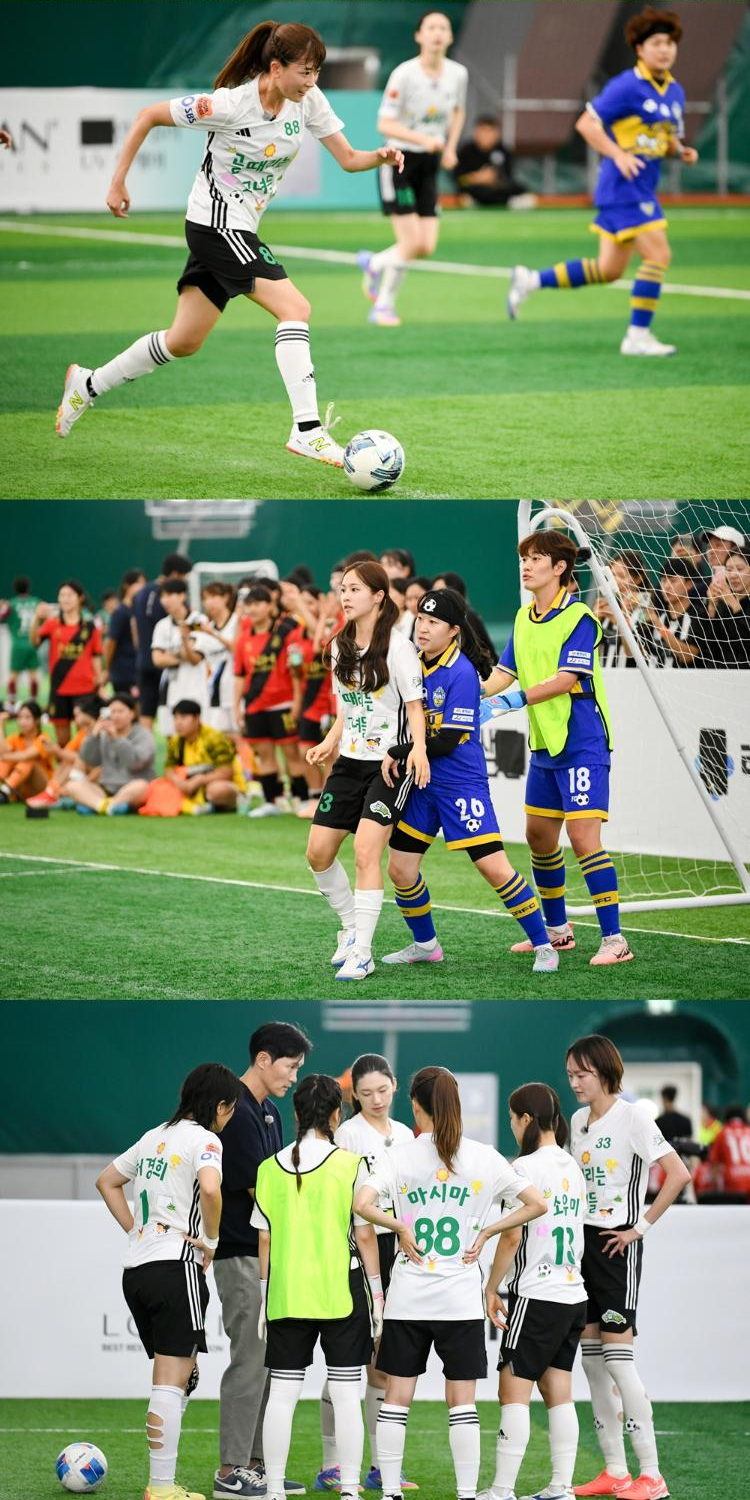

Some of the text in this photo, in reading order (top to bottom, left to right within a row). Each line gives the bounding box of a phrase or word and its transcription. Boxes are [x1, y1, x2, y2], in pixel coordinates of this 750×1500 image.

[184, 107, 198, 125] SBS
[284, 120, 300, 136] 88
[341, 691, 374, 712] 때리는
[568, 766, 591, 794] 18
[595, 1136, 612, 1149] 33
[407, 1183, 470, 1207] 마시마
[553, 1194, 581, 1217] 소유미
[140, 1188, 150, 1226] 1
[414, 1216, 461, 1257] 88
[551, 1225, 576, 1266] 13
